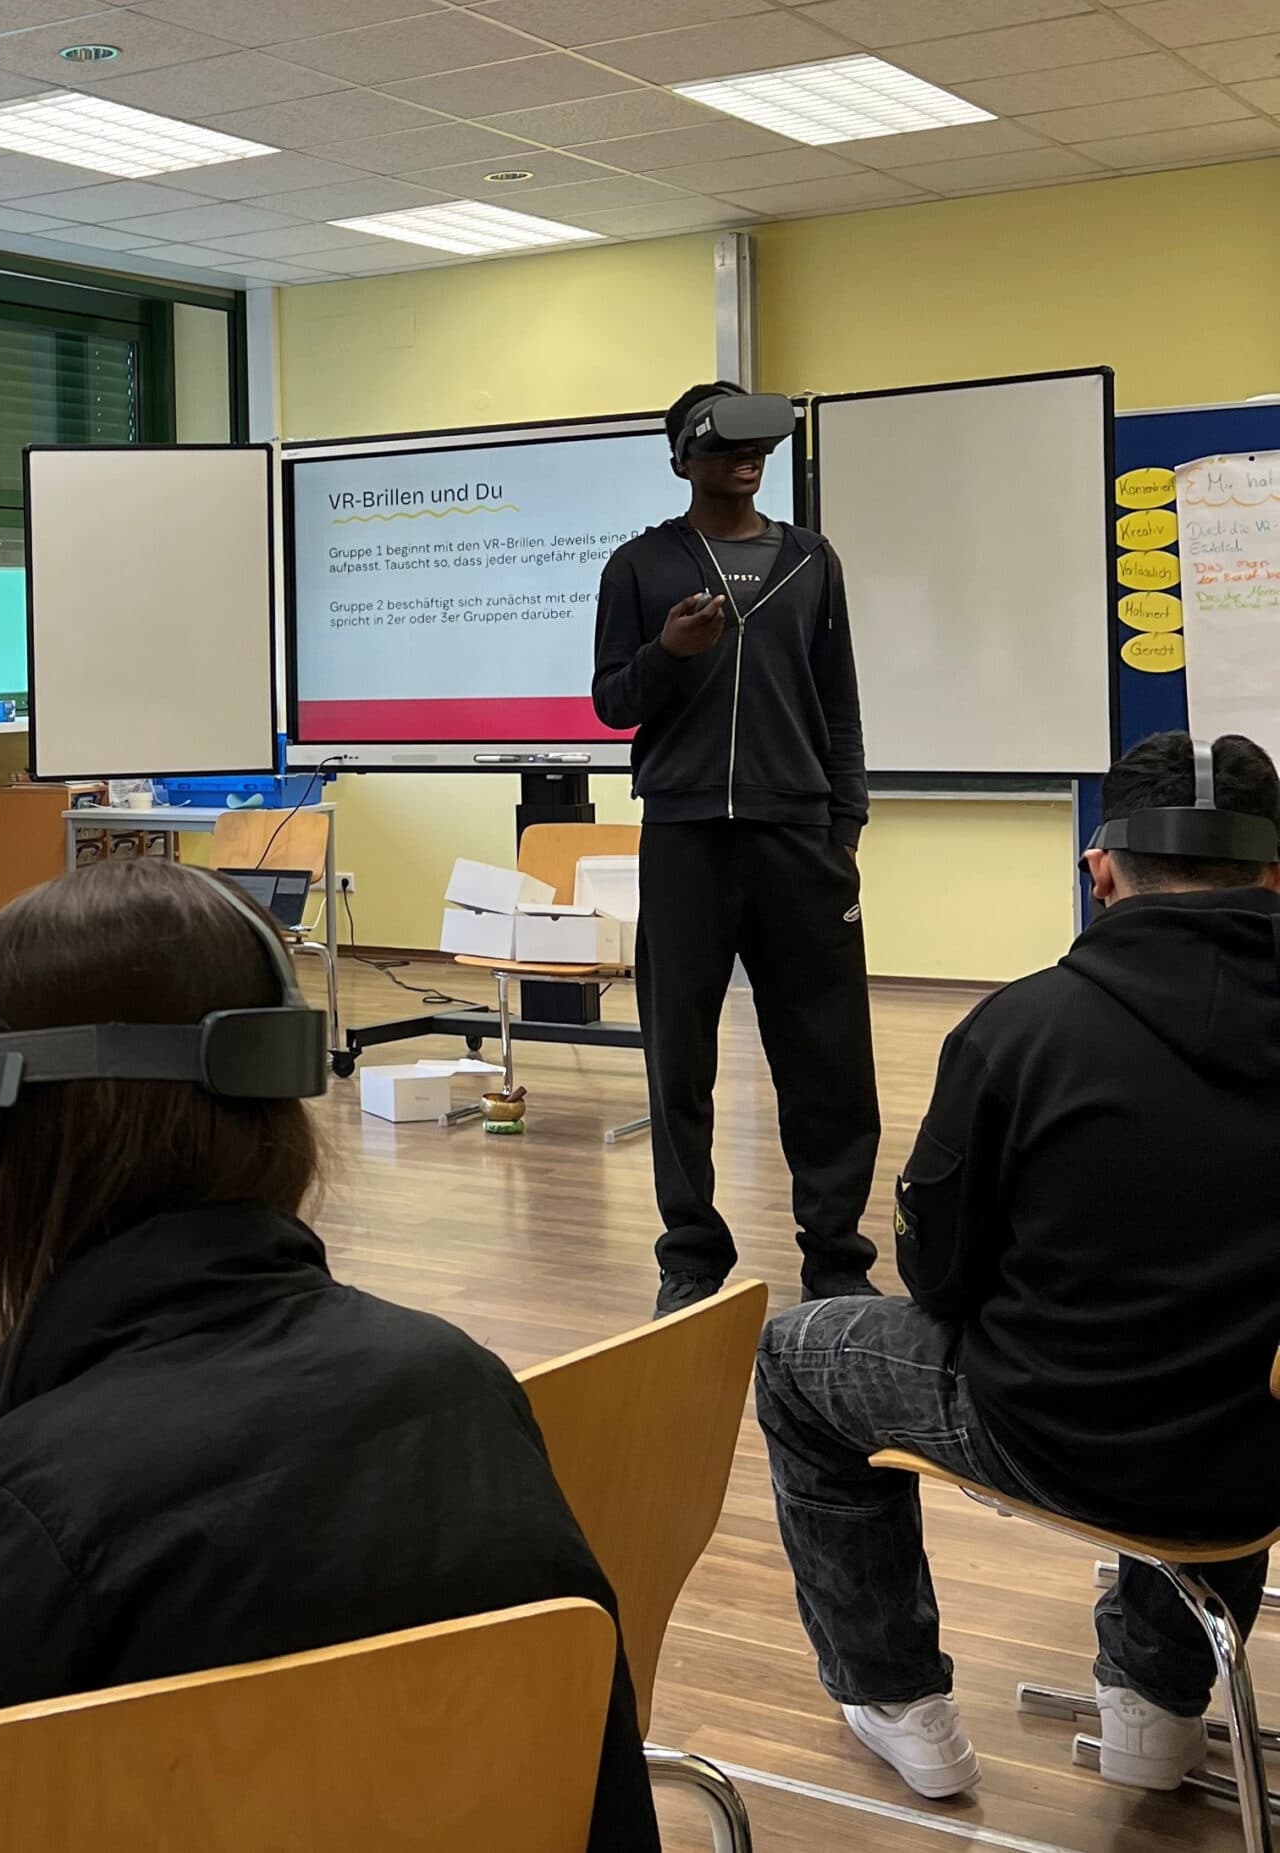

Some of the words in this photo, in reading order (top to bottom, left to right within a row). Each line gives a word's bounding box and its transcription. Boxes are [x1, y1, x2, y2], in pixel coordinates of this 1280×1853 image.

[328, 486, 425, 510] VR-Brillen
[430, 484, 469, 504] und
[475, 482, 503, 501] Du
[1119, 520, 1165, 541] Kreativ
[328, 546, 373, 561] Gruppe
[376, 545, 383, 556] 1
[386, 543, 431, 559] beginnt
[433, 540, 454, 553] mit
[456, 538, 480, 552] den
[549, 533, 597, 548] Jeweils
[600, 532, 627, 544] eine
[328, 560, 381, 574] aufpasst.
[385, 557, 431, 571] Tauscht
[433, 558, 451, 570] so,
[453, 555, 482, 568] dass
[484, 553, 517, 569] jeder
[520, 550, 577, 566] ungefähr
[329, 600, 374, 615] Gruppe
[376, 599, 384, 611] 2
[386, 597, 455, 612] beschäftigt
[458, 595, 483, 608] sich
[485, 593, 543, 606] zunächst
[545, 591, 567, 604] mit
[569, 591, 591, 603] der
[329, 615, 371, 629] spricht
[373, 614, 384, 625] in
[386, 614, 406, 626] 2er
[409, 612, 437, 624] oder
[440, 611, 461, 624] 3er
[463, 610, 519, 626] Gruppen
